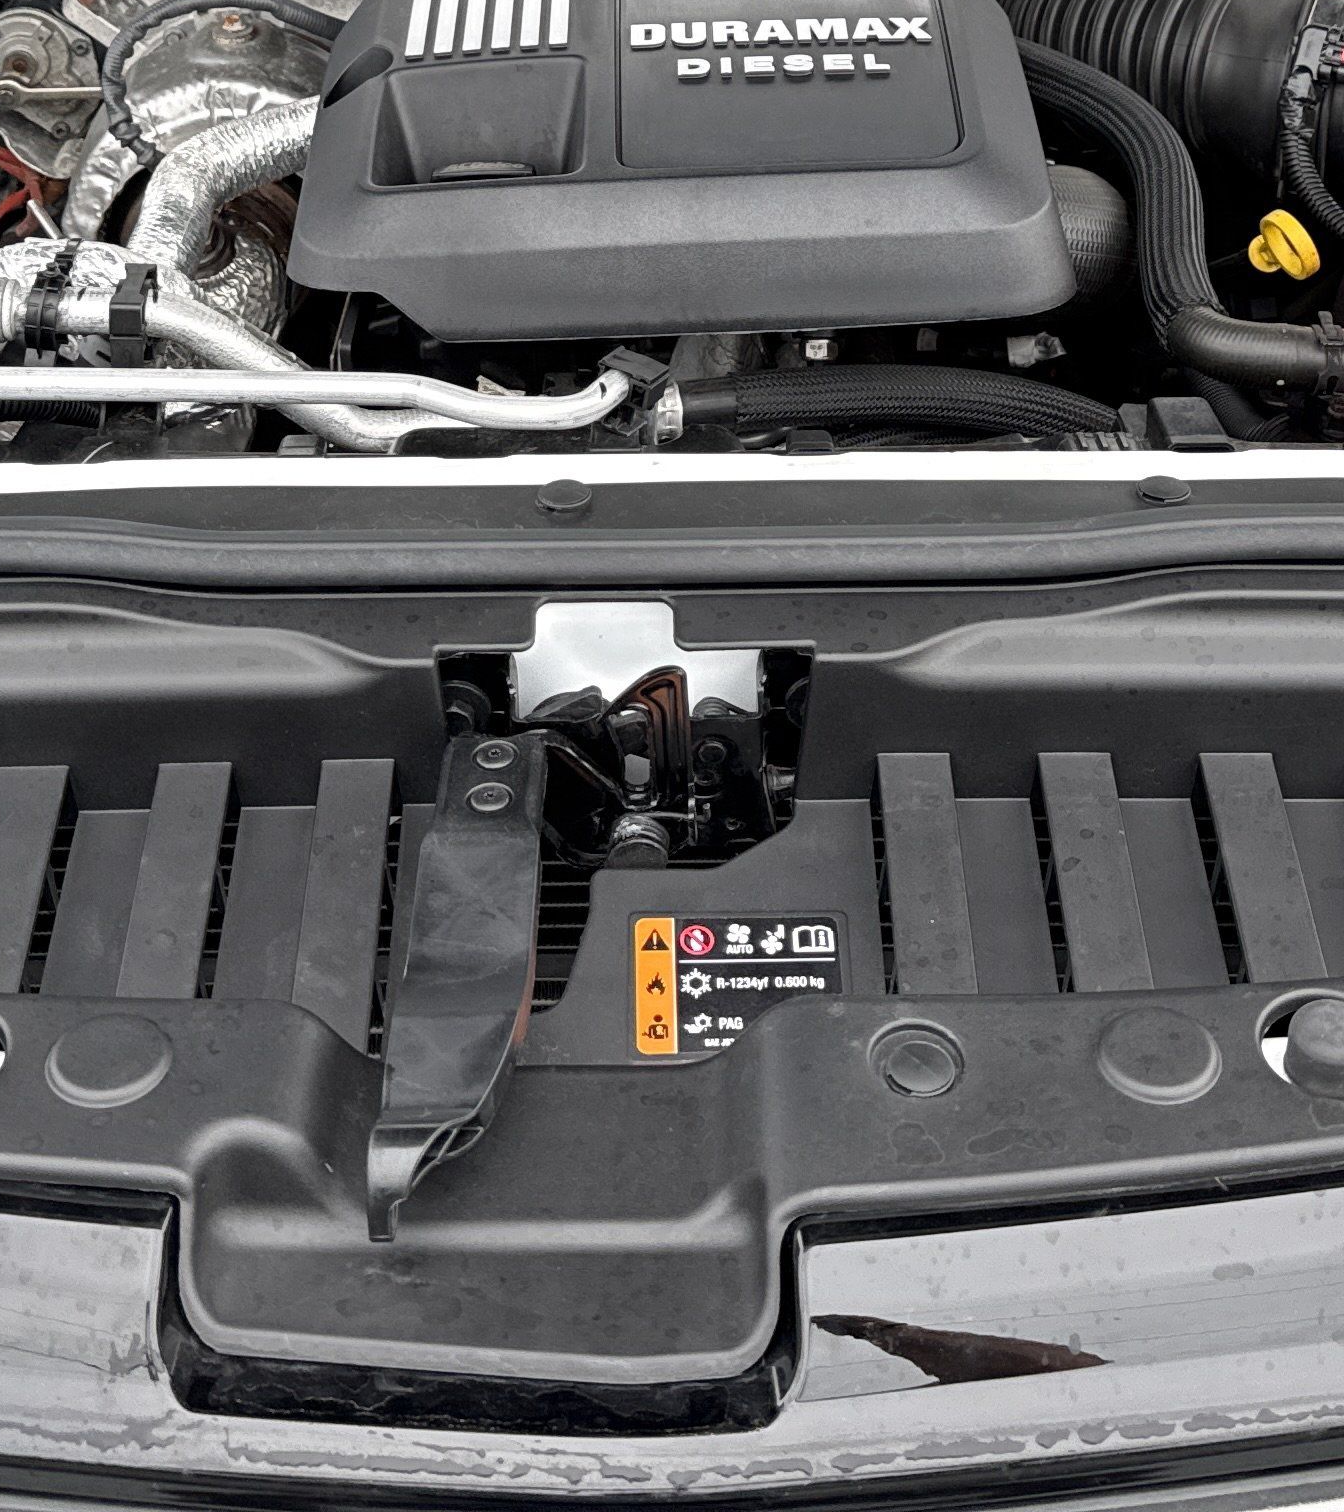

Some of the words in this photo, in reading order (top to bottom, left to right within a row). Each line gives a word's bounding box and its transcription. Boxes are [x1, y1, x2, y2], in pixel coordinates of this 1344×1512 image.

[630, 17, 932, 49] DURAMAX
[677, 53, 891, 79] DIESEL
[726, 944, 754, 955] AUTO
[716, 976, 770, 991] R-1234yf
[809, 975, 825, 990] kg
[718, 1016, 744, 1030] PAG
